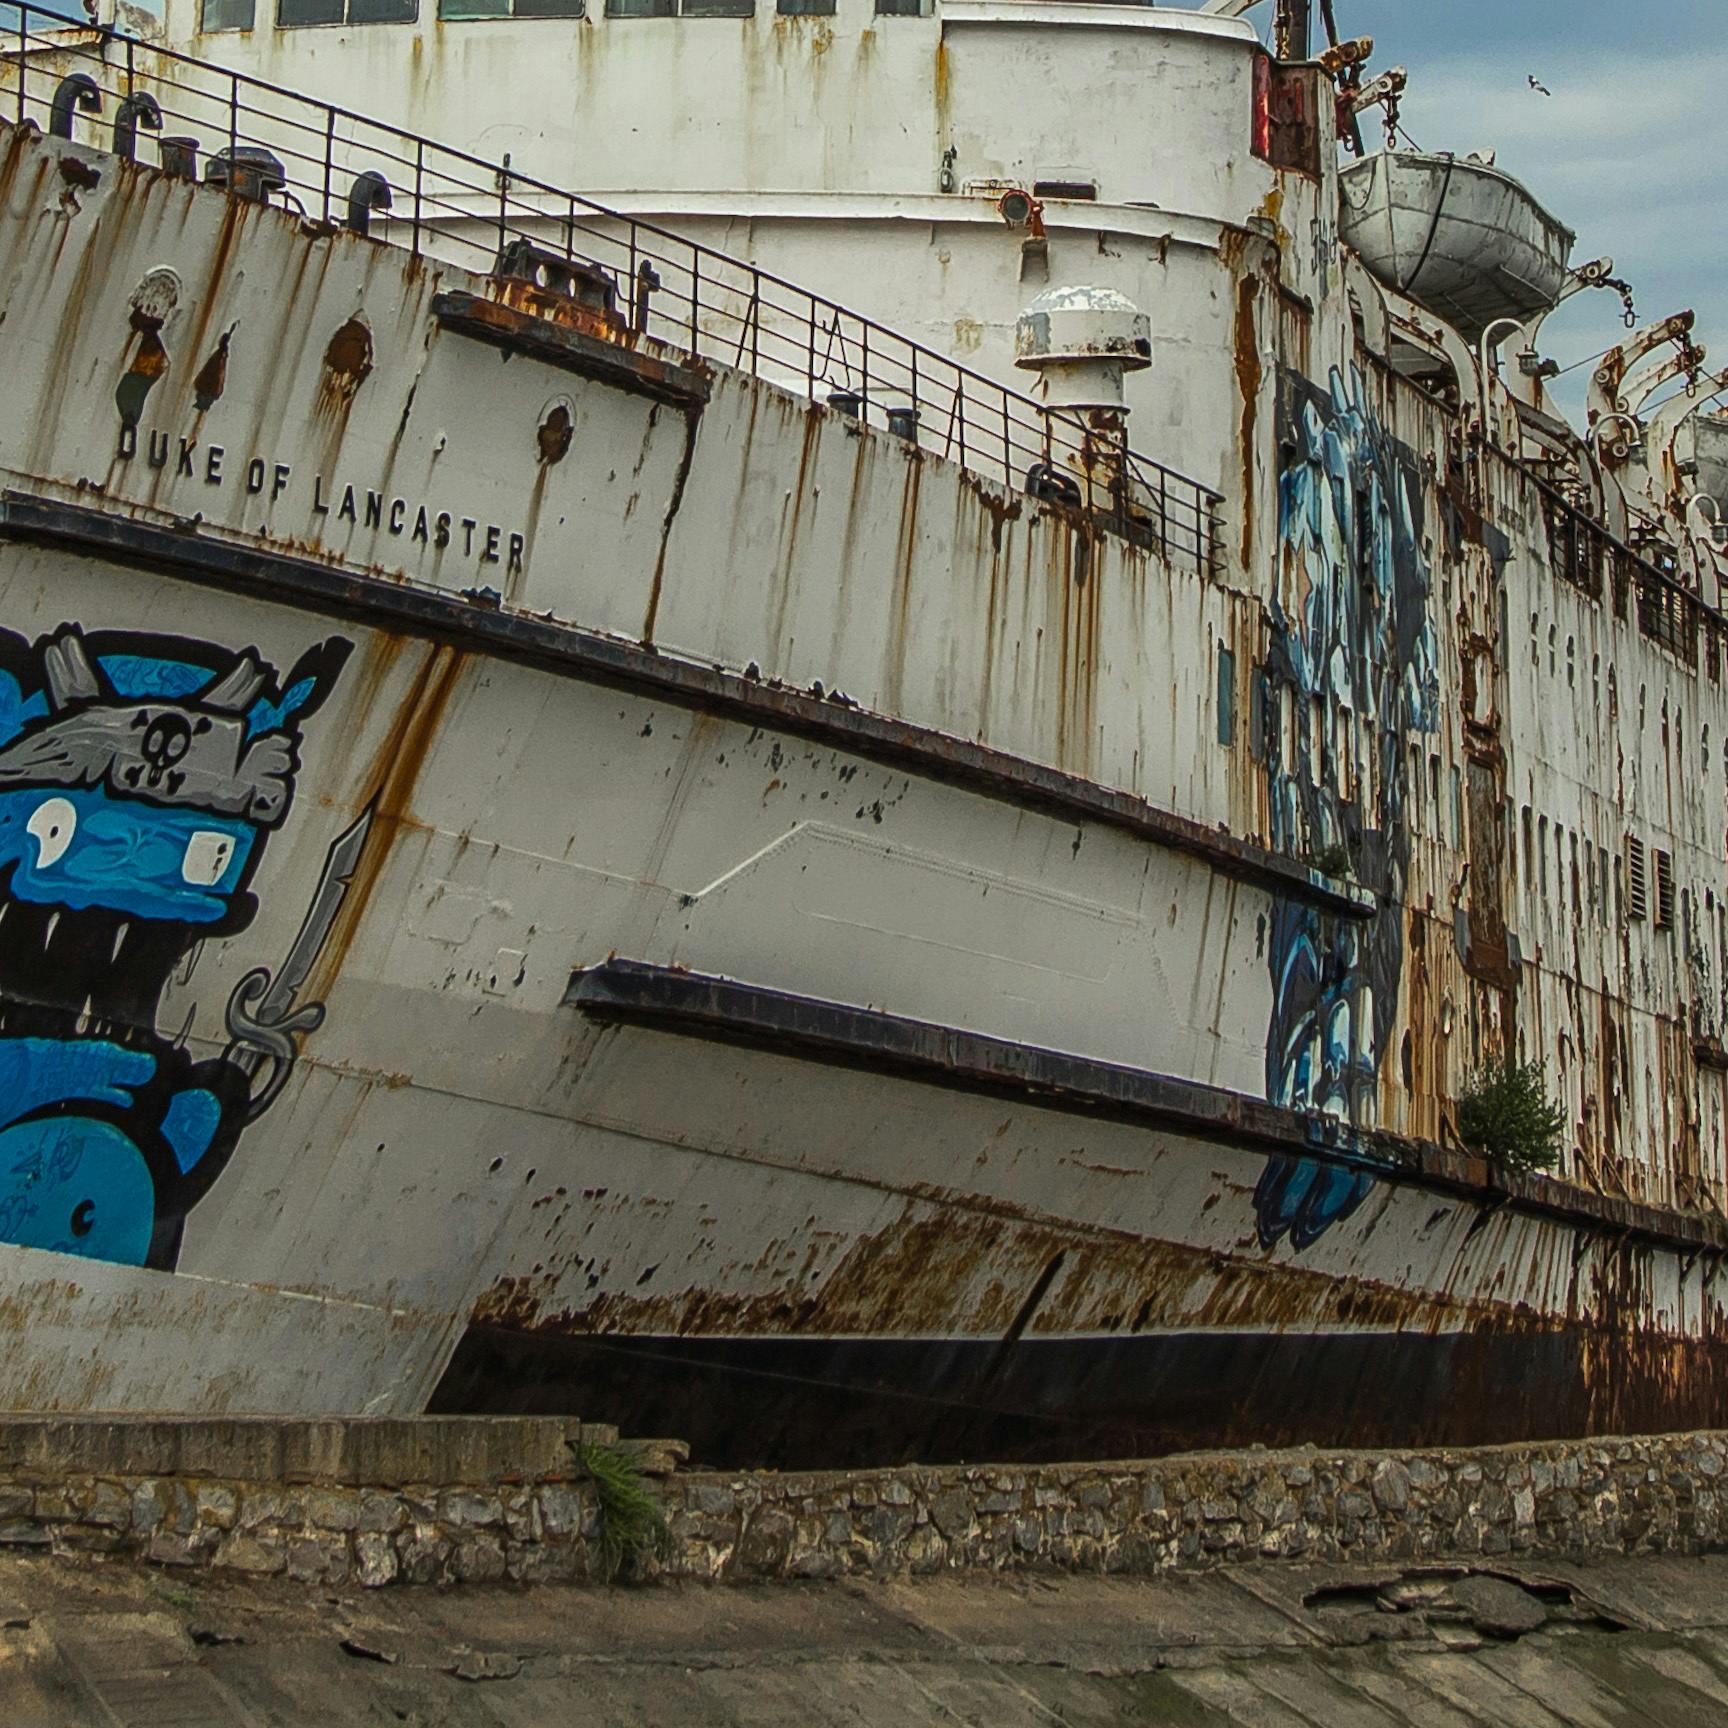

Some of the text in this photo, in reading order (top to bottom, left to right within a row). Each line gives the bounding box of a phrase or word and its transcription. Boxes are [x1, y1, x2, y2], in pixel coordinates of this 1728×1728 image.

[117, 423, 524, 574] DUKE OF LANCASTER
